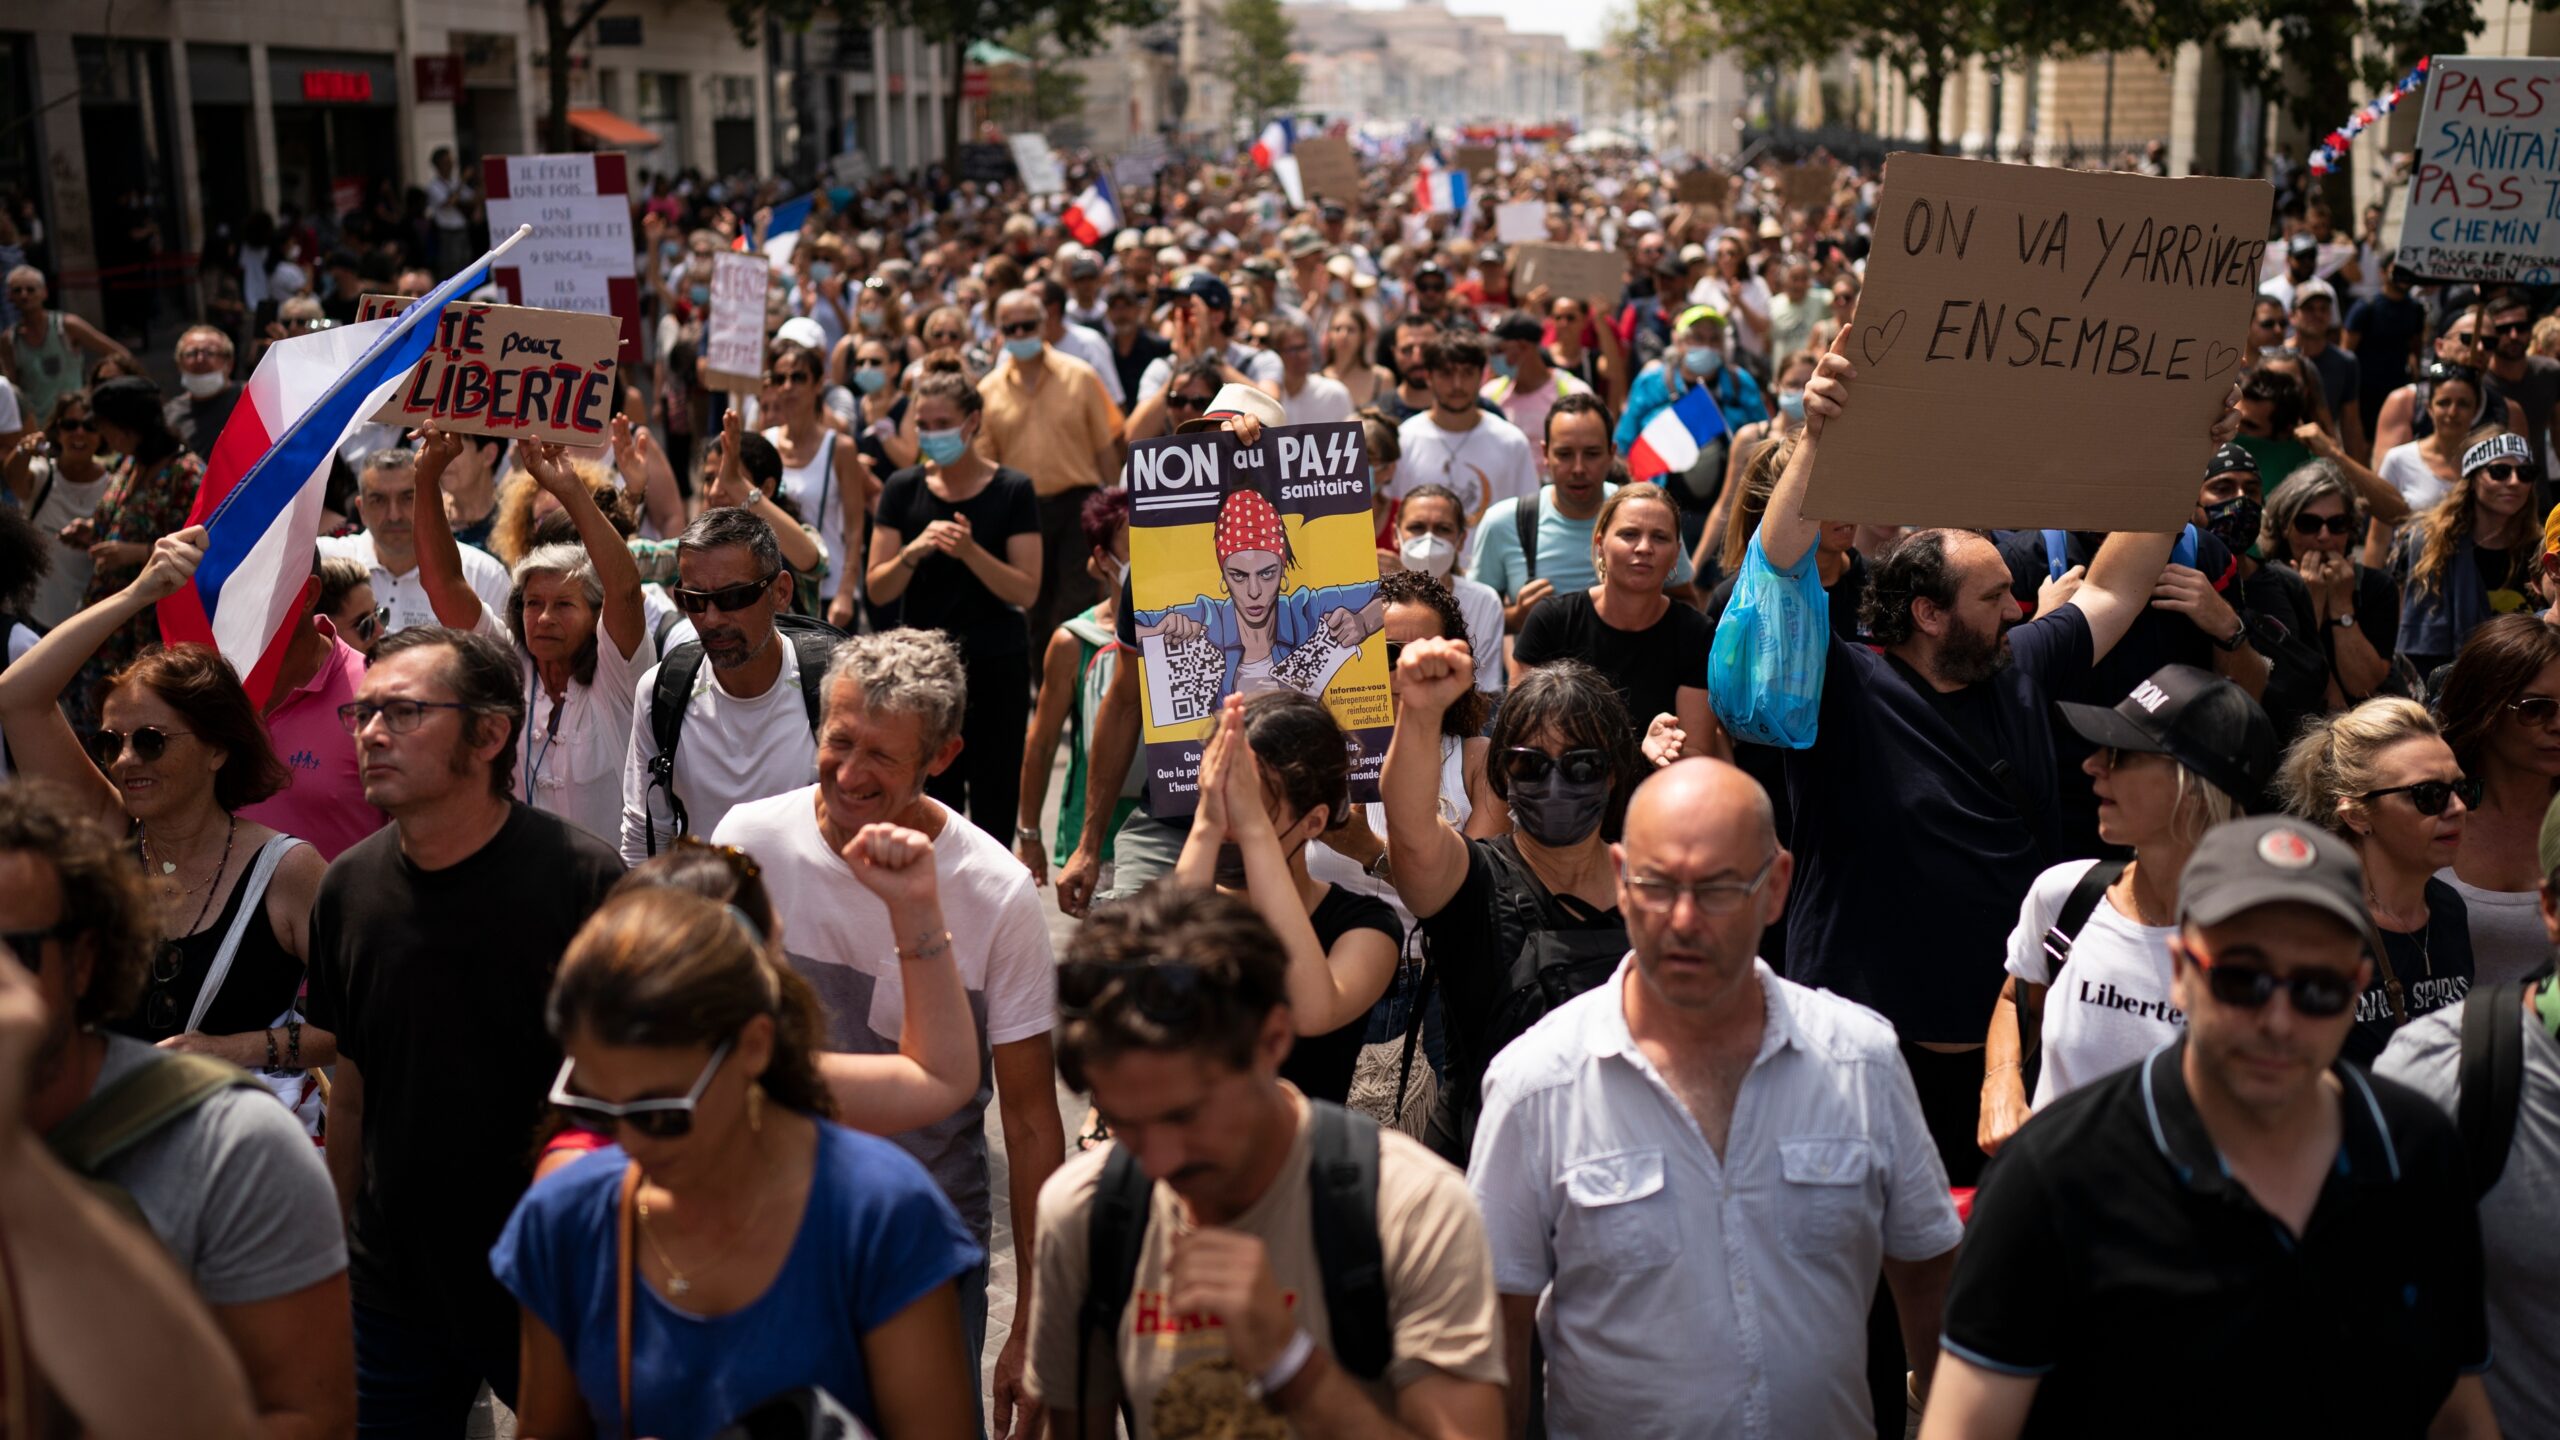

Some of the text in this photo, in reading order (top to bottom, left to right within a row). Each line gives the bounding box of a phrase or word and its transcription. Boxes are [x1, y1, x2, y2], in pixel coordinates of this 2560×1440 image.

[2432, 120, 2560, 171] SANITAI
[1903, 197, 1978, 260] ON
[2018, 209, 2069, 273] VA
[500, 330, 563, 361] pour
[1925, 298, 2197, 381] ENSEMBLE
[404, 347, 615, 433] LIBERTÉ
[1133, 431, 1360, 492] NON au PASS
[1281, 478, 1364, 500] sanitaire
[1330, 683, 1387, 695] Informez-vous
[1330, 694, 1388, 706] lelibrepenseur.org
[1347, 703, 1389, 715] reinfocovid.fr
[1352, 715, 1390, 726] covidhub.ch
[1184, 751, 1201, 762] Que
[1157, 768, 1175, 779] Que
[1176, 766, 1185, 777] la
[1168, 781, 1199, 793] L'heure
